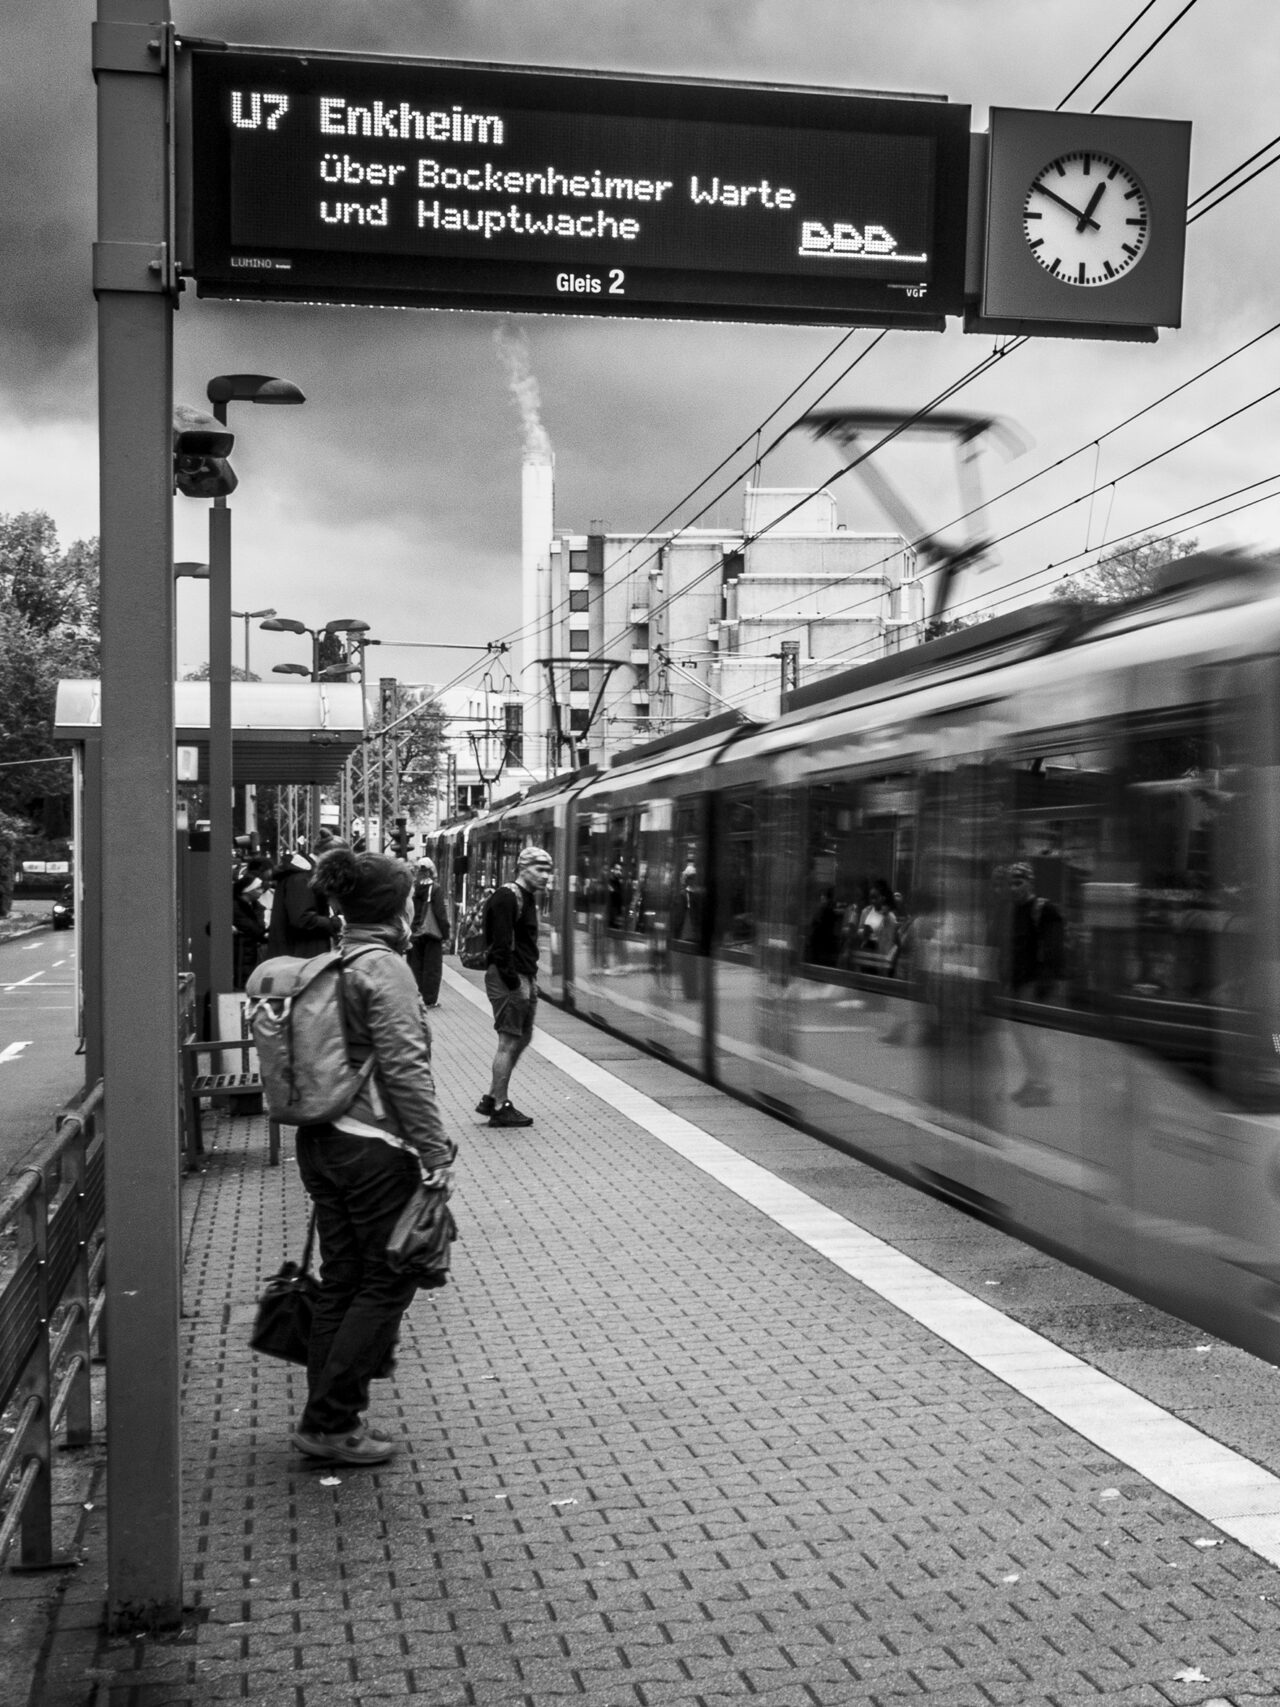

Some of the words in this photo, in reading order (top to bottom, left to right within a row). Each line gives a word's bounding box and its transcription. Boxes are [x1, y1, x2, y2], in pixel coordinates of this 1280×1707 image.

[231, 91, 289, 131] U7
[319, 96, 505, 146] Enkheim
[319, 153, 407, 188] über
[417, 158, 674, 203] Bockenheimer
[690, 175, 797, 210] Warte
[319, 197, 388, 227] und
[417, 199, 641, 240] Hauptwache
[231, 257, 272, 269] LUMINO
[556, 272, 602, 293] Gleis
[608, 268, 625, 295] 2
[906, 283, 927, 298] VGF
